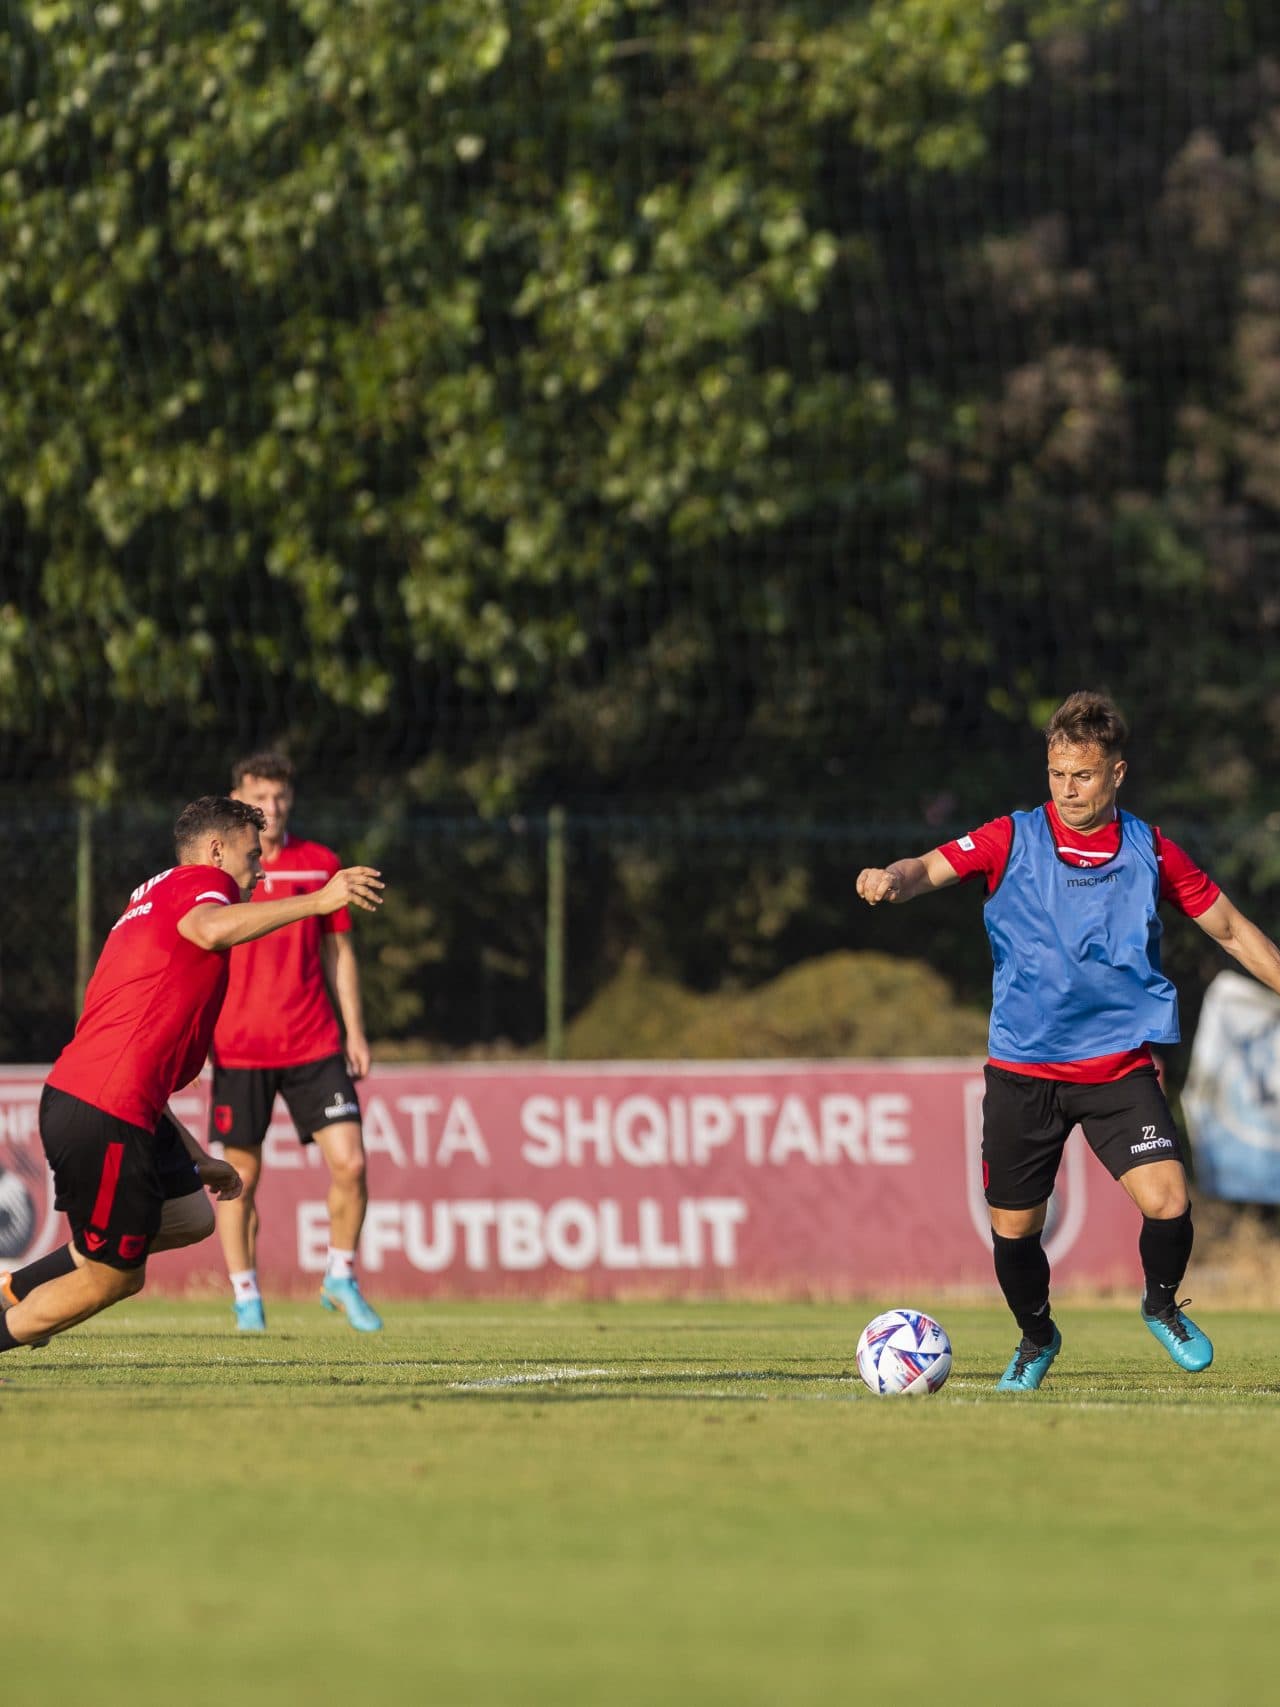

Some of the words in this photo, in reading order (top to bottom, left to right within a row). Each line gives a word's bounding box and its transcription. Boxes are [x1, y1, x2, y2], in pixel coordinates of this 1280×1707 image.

[520, 1093, 912, 1168] SHQIPTARE
[1130, 1137, 1172, 1154] macron
[1141, 1125, 1157, 1140] 22
[363, 1199, 746, 1270] FUTBOLLIT
